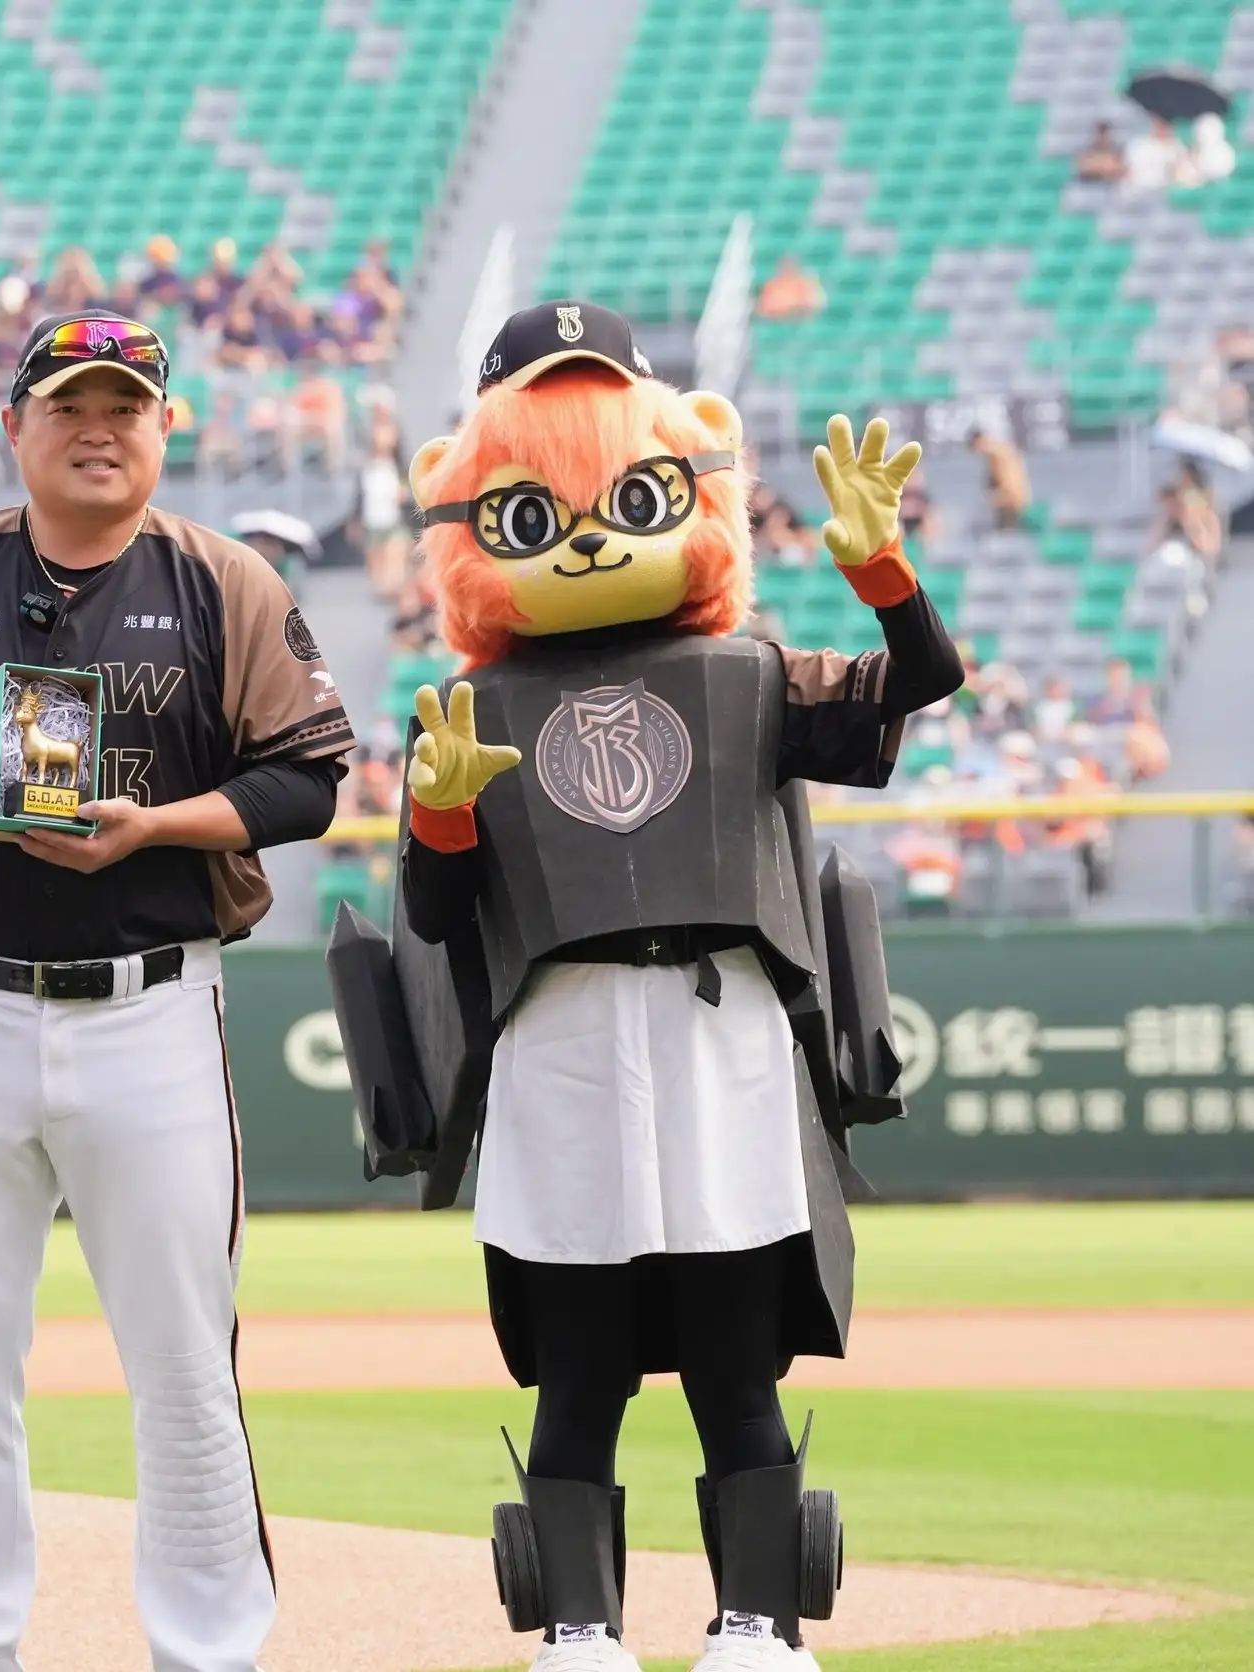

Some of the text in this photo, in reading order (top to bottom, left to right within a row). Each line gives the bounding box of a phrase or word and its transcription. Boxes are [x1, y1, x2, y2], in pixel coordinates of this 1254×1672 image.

[551, 724, 568, 756] CIRU
[650, 712, 678, 769] UNILIONS
[100, 747, 154, 808] 13
[27, 790, 76, 807] G.O.A.T
[577, 1629, 597, 1637] AIR
[743, 1623, 763, 1633] AIR
